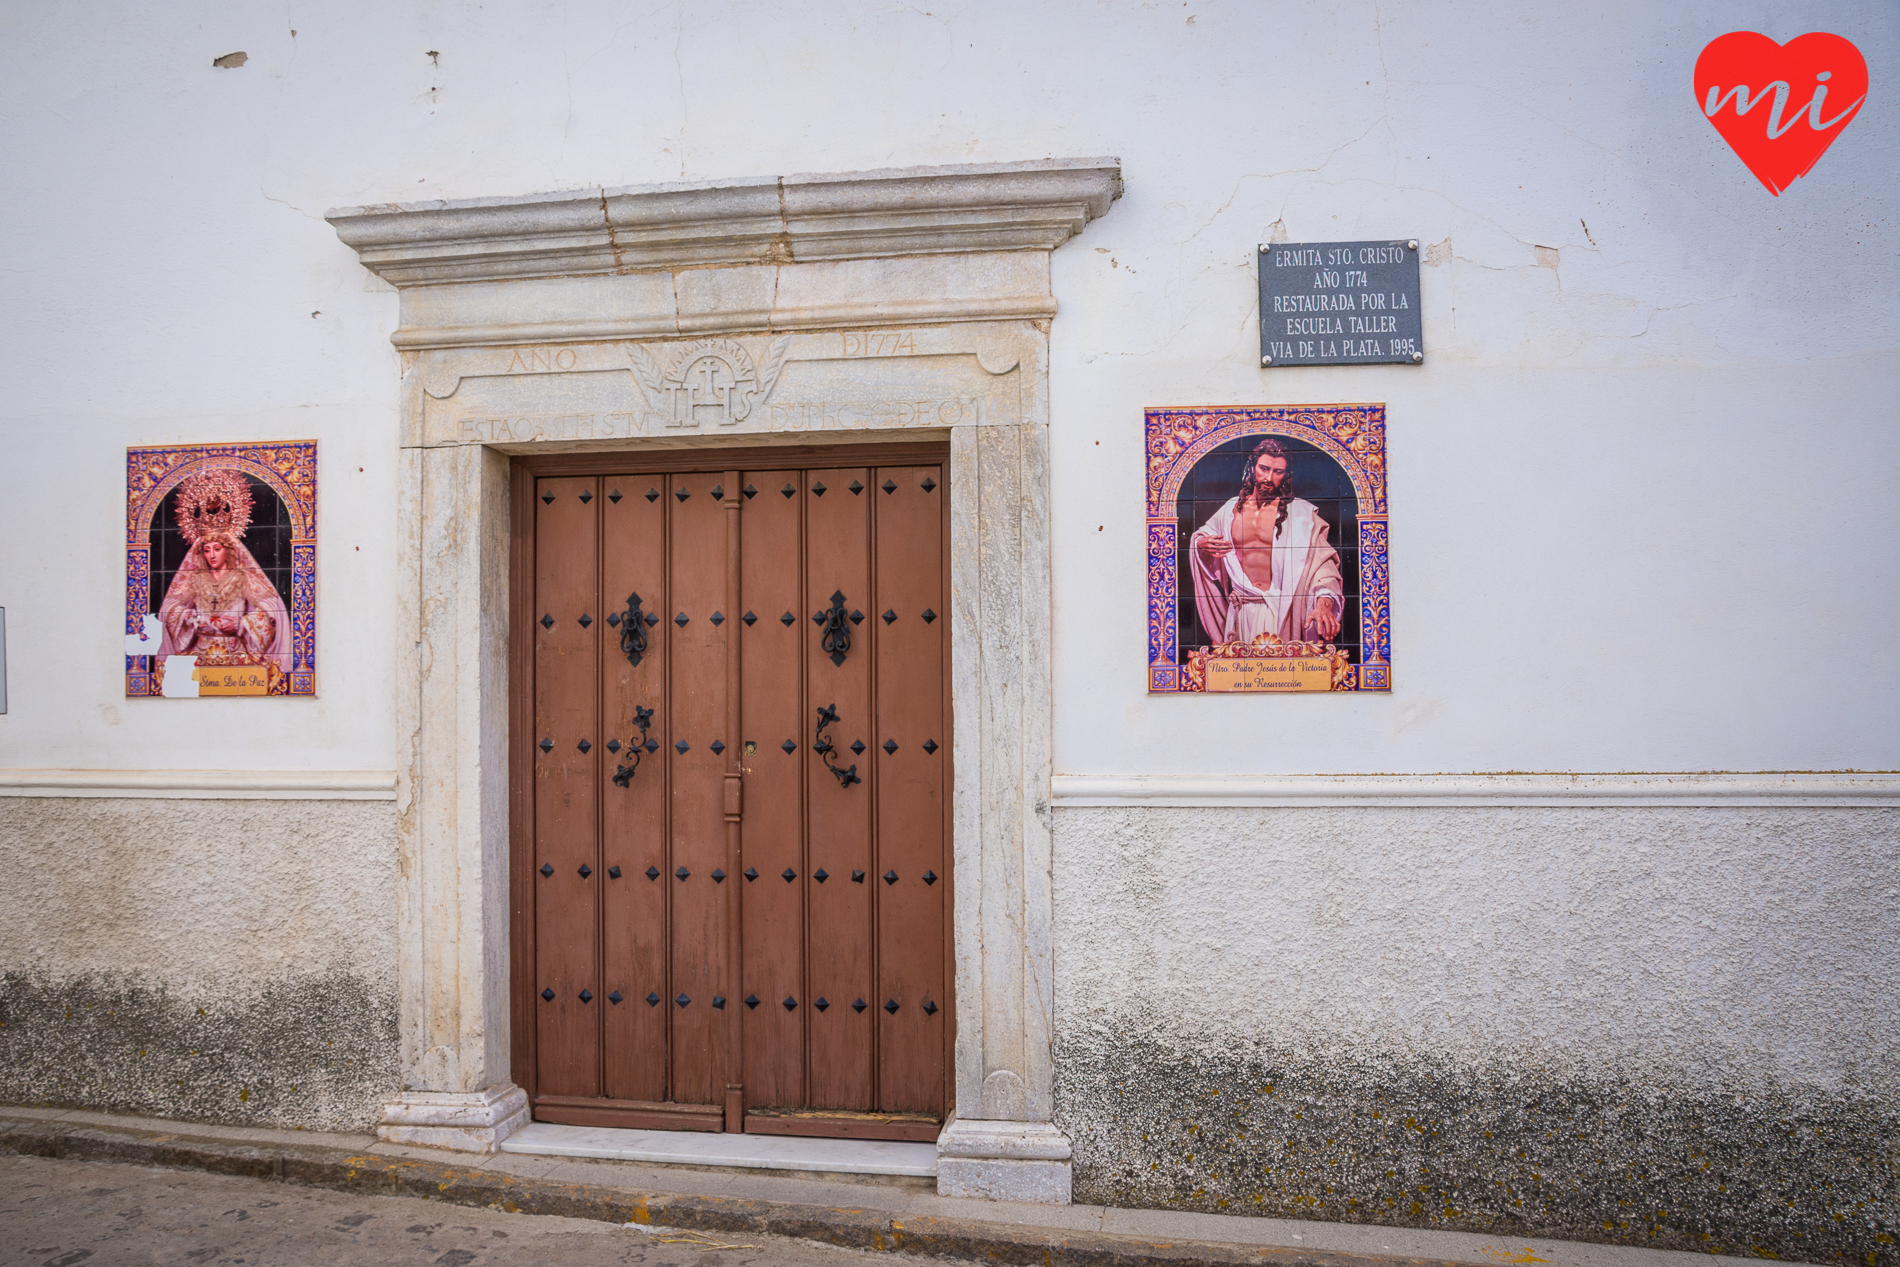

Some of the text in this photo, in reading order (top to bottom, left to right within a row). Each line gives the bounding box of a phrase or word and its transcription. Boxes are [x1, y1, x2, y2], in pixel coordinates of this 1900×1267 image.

[1276, 247, 1404, 267] ERMITA STO. CRISTO
[1313, 268, 1368, 288] AÑO 1774
[1274, 292, 1409, 312] RESTAURADA POR LA
[1287, 316, 1397, 335] ESCUELA TALLER
[1270, 338, 1415, 358] VIA DE LA PLATA. 1995
[1208, 661, 1328, 676] Ntro. Padre Jesús de la Victoria
[223, 675, 237, 687] De
[238, 675, 247, 687] la
[248, 675, 266, 687] Paz
[1233, 677, 1303, 689] en su Resurrección
